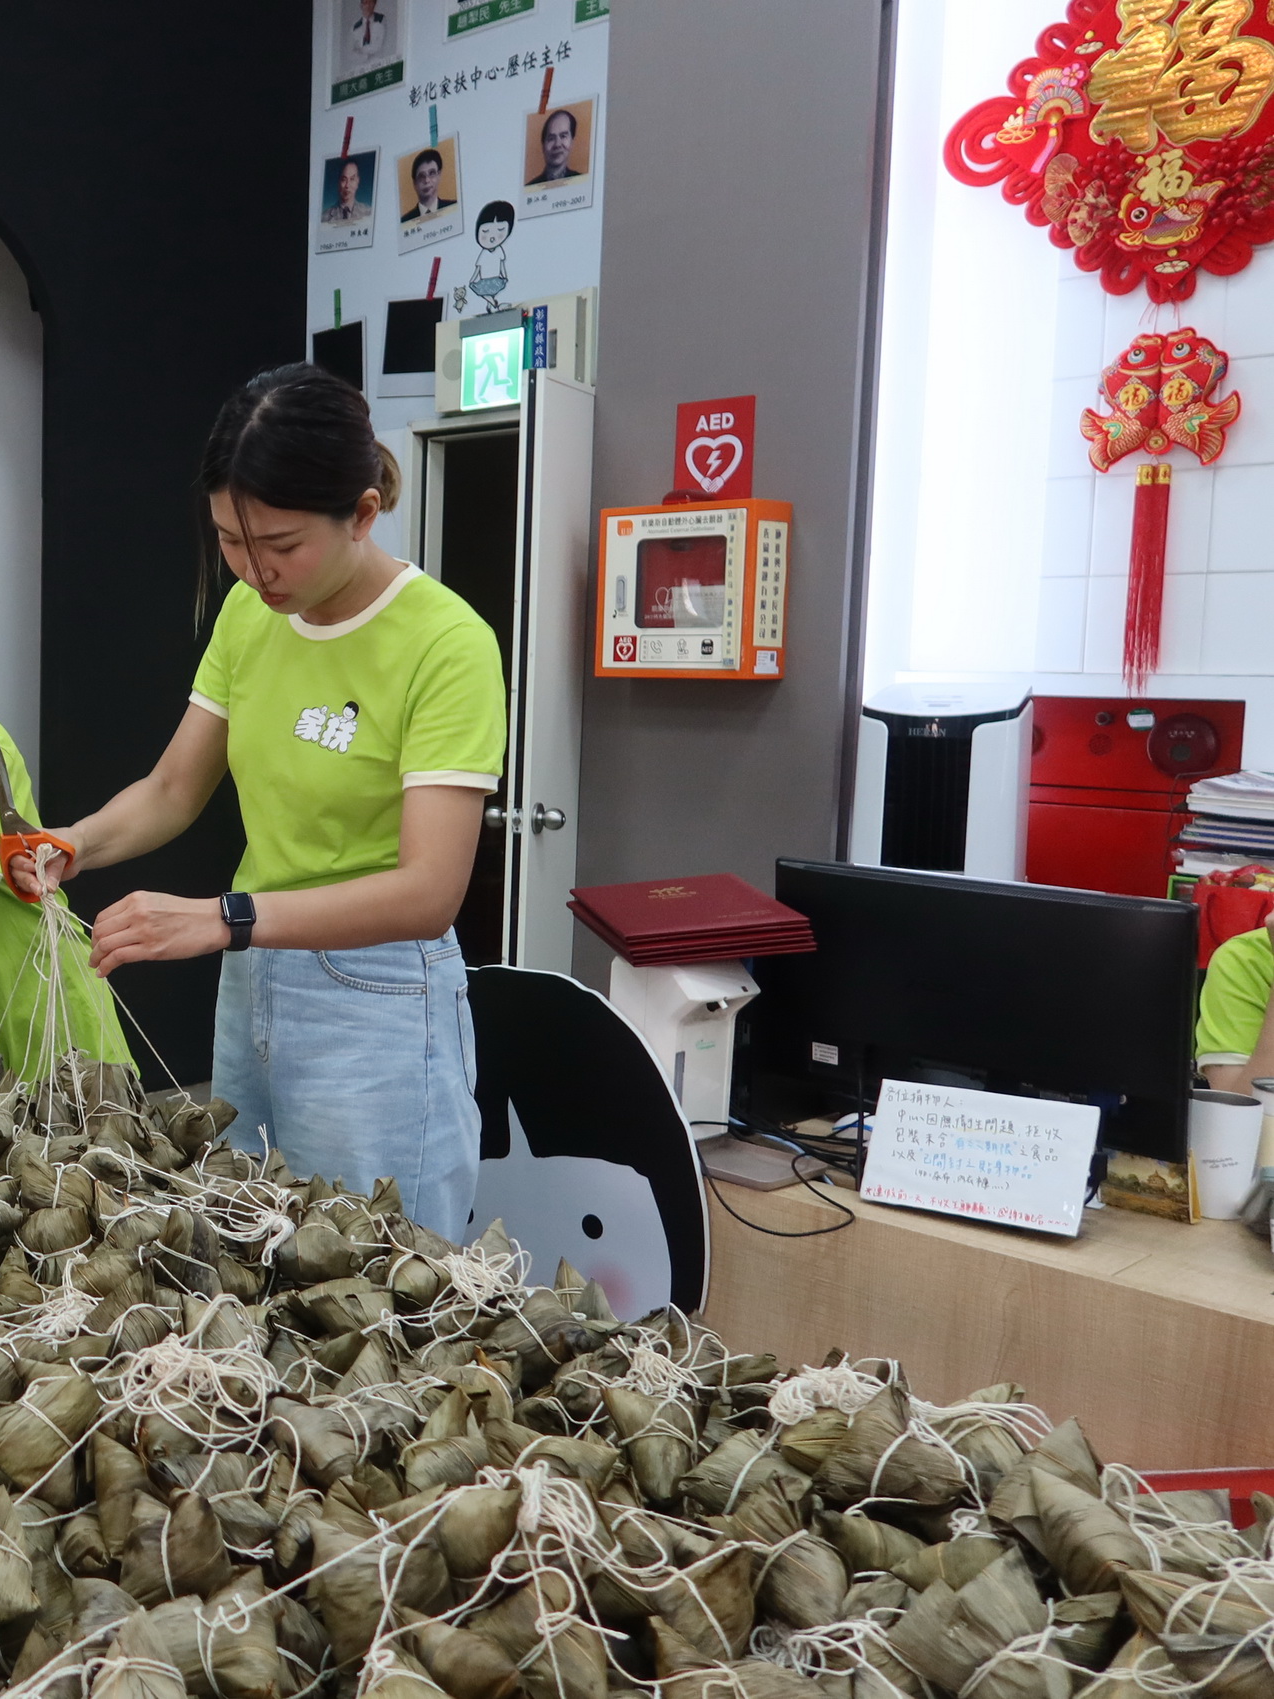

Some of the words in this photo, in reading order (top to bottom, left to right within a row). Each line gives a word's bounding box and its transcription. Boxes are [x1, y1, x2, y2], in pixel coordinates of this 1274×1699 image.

[1088, 0, 1274, 152] 福
[1137, 148, 1194, 204] 福
[695, 411, 735, 433] AED
